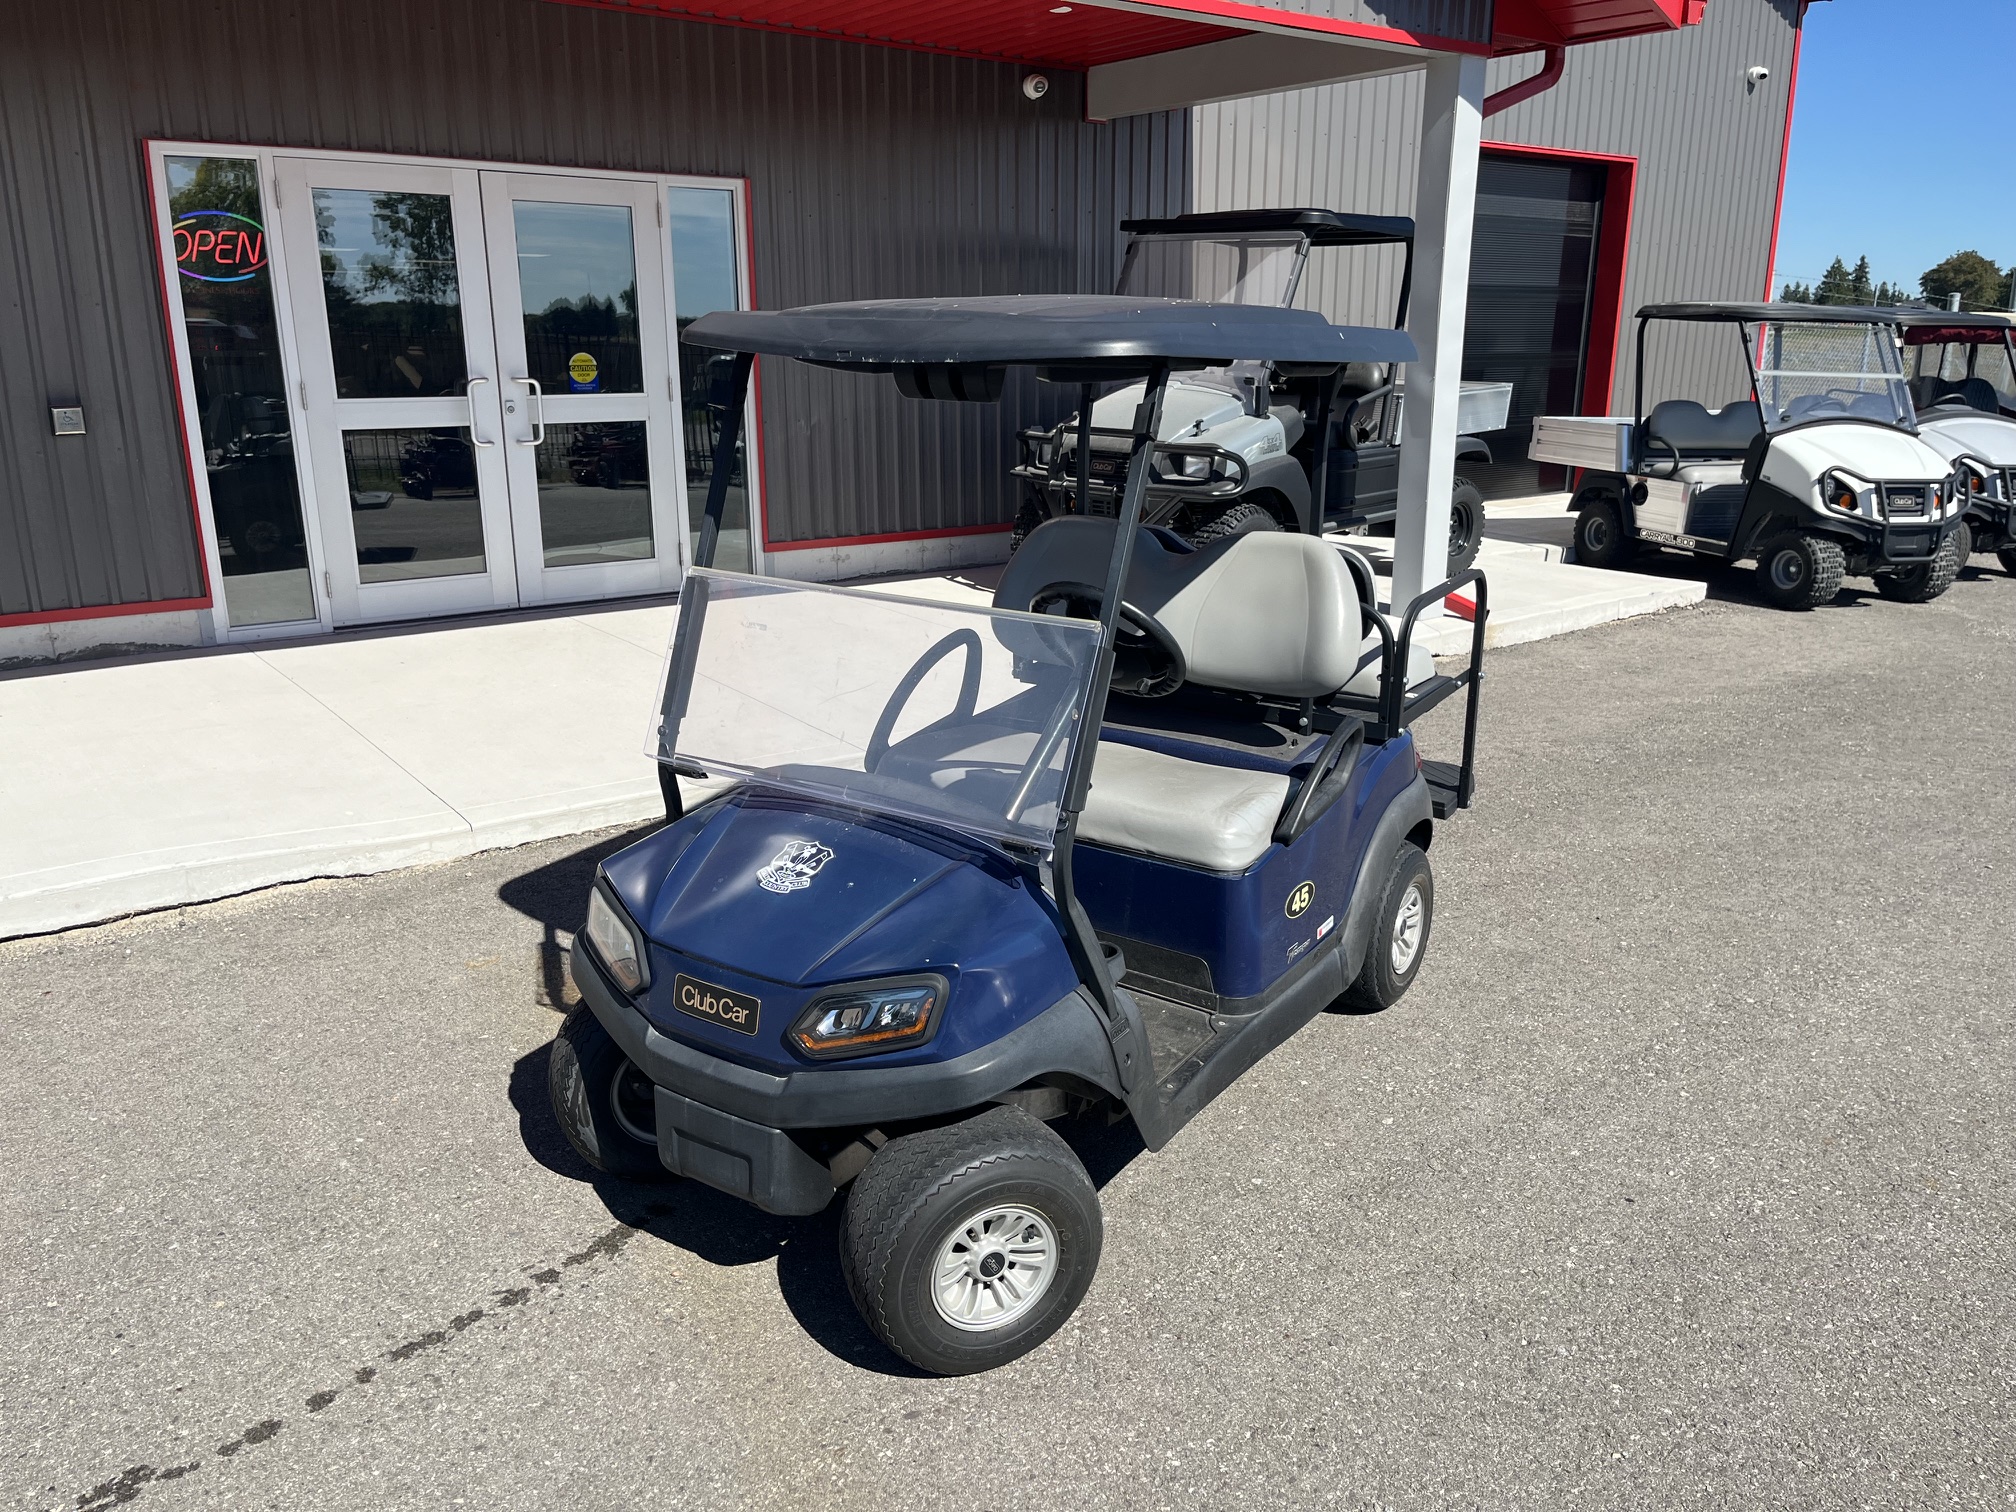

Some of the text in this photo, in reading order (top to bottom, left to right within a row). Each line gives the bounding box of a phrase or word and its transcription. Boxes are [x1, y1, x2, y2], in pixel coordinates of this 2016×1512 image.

[173, 229, 263, 264] OPEN
[1640, 528, 1696, 549] CARRYALL 300
[791, 880, 808, 888] CLUB
[1291, 885, 1309, 912] 45
[681, 985, 750, 1024] Club Car
